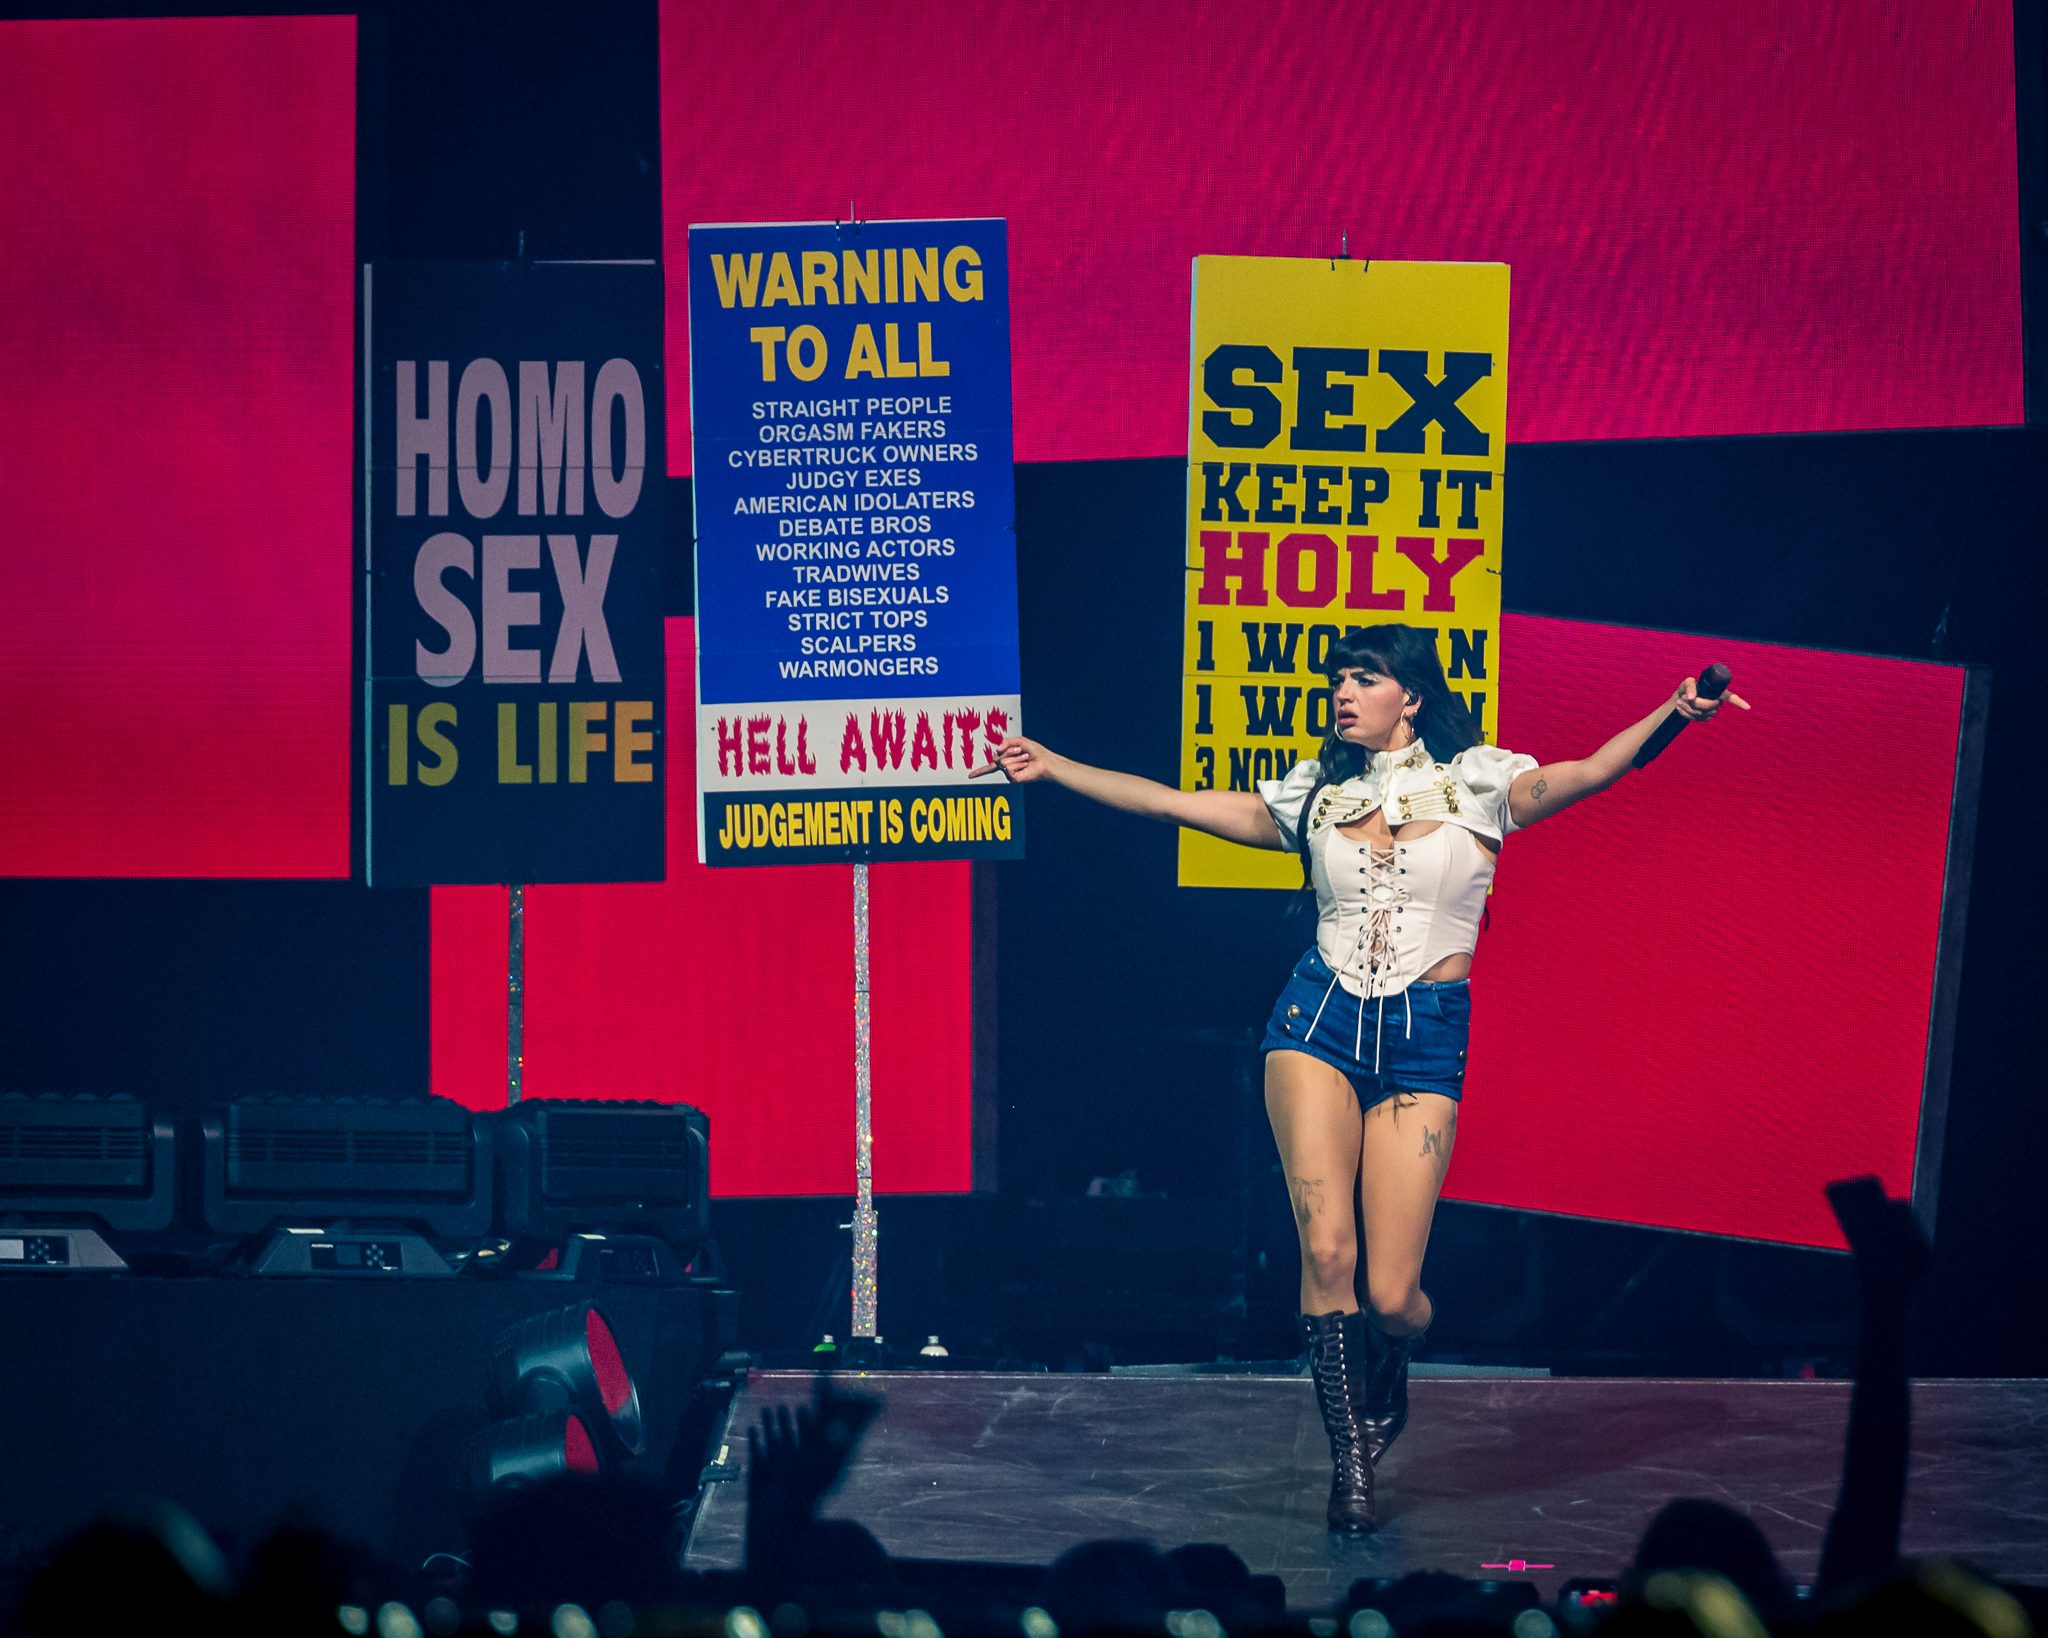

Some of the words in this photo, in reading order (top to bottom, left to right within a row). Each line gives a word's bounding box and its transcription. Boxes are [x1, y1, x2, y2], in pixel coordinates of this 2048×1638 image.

[710, 246, 983, 308] WARNING
[750, 325, 828, 382] TO
[845, 322, 950, 379] ALL
[753, 400, 859, 419] STRAIGHT
[867, 397, 951, 415] PEOPLE
[1202, 345, 1492, 456] SEX
[397, 358, 645, 518] HOMO
[760, 424, 853, 443] ORGASM
[861, 420, 945, 440] FAKERS
[729, 447, 876, 467] CYBERTRUCK
[883, 444, 977, 463] OWNERS
[786, 471, 857, 489] JUDGY
[865, 469, 921, 487] EXES
[1201, 462, 1389, 525] KEEP
[1419, 469, 1492, 529] IT
[734, 495, 846, 514] AMERICAN
[855, 491, 975, 511] IDOLATERS
[780, 518, 863, 537] DEBATE
[871, 515, 931, 534] BROS
[756, 543, 860, 561] WORKING
[866, 538, 955, 557] ACTORS
[1198, 531, 1484, 612] HOLY
[793, 563, 919, 583] TRADWIVES
[414, 533, 622, 686] SEX
[766, 590, 821, 608] FAKE
[829, 586, 949, 606] BISEXUALS
[789, 612, 864, 631] STRICT
[870, 610, 927, 628] TOPS
[802, 634, 916, 654] SCALPERS
[1197, 621, 1215, 671] 1
[1242, 622, 1487, 679] WON
[779, 657, 938, 678] WARMONGERS
[1195, 684, 1213, 734] 1
[390, 703, 457, 785] IS
[499, 701, 653, 783] LIFE
[718, 714, 816, 777] HELL
[840, 706, 1008, 772] AWAITS
[1195, 747, 1214, 791] 3
[719, 801, 873, 849] JUDGEMENT
[880, 799, 903, 844] IS
[910, 796, 1011, 843] COMING
